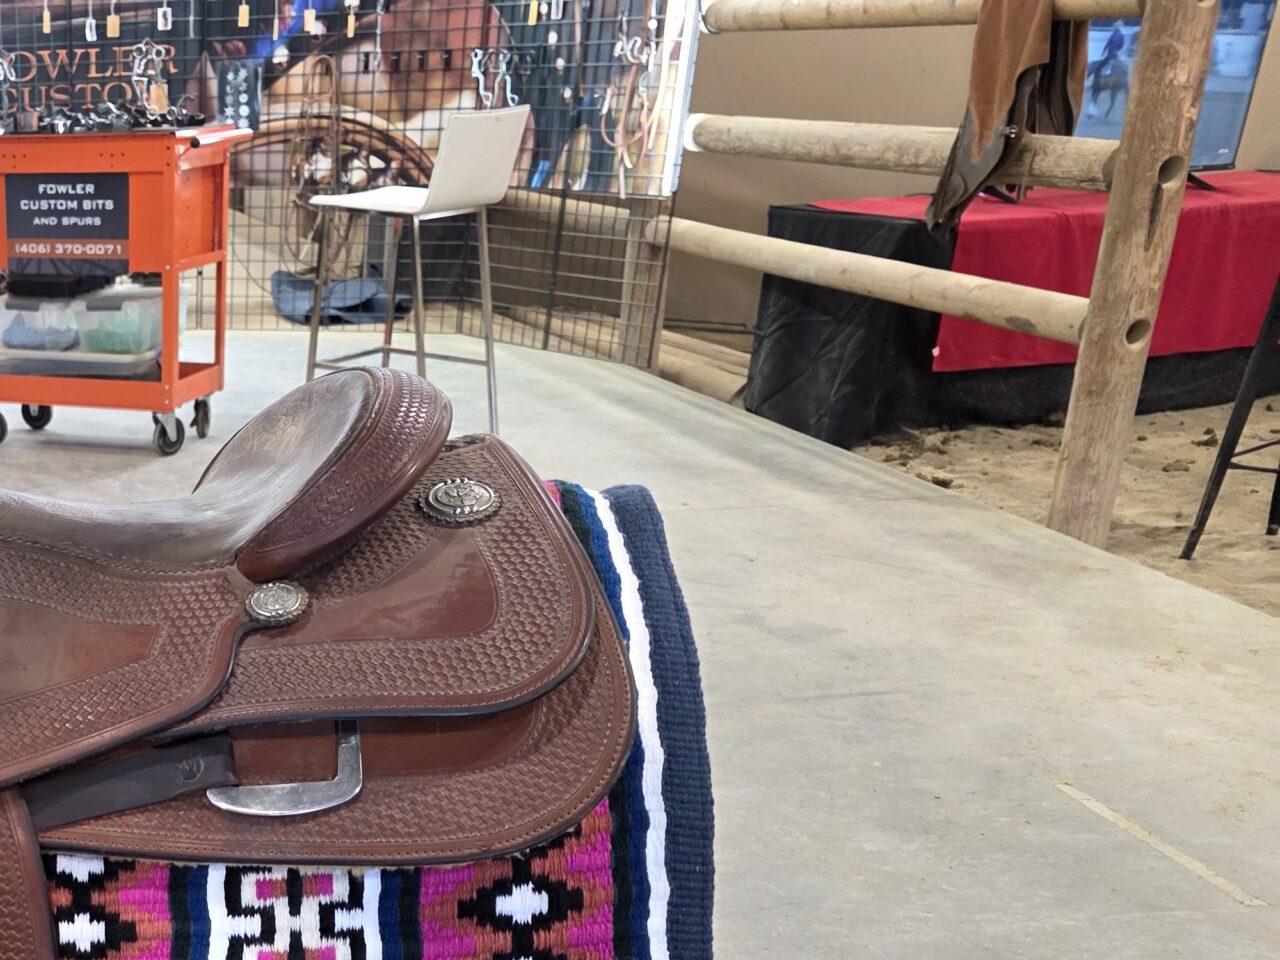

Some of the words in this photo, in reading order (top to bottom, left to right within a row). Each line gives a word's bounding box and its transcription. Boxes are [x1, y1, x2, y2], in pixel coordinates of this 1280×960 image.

[38, 184, 95, 194] FOWLER
[20, 200, 77, 210] CUSTOM
[82, 200, 114, 210] BITS
[33, 217, 57, 225] AND
[61, 217, 101, 225] SPURS
[15, 244, 51, 254] (406)
[55, 244, 121, 255] 370-0071
